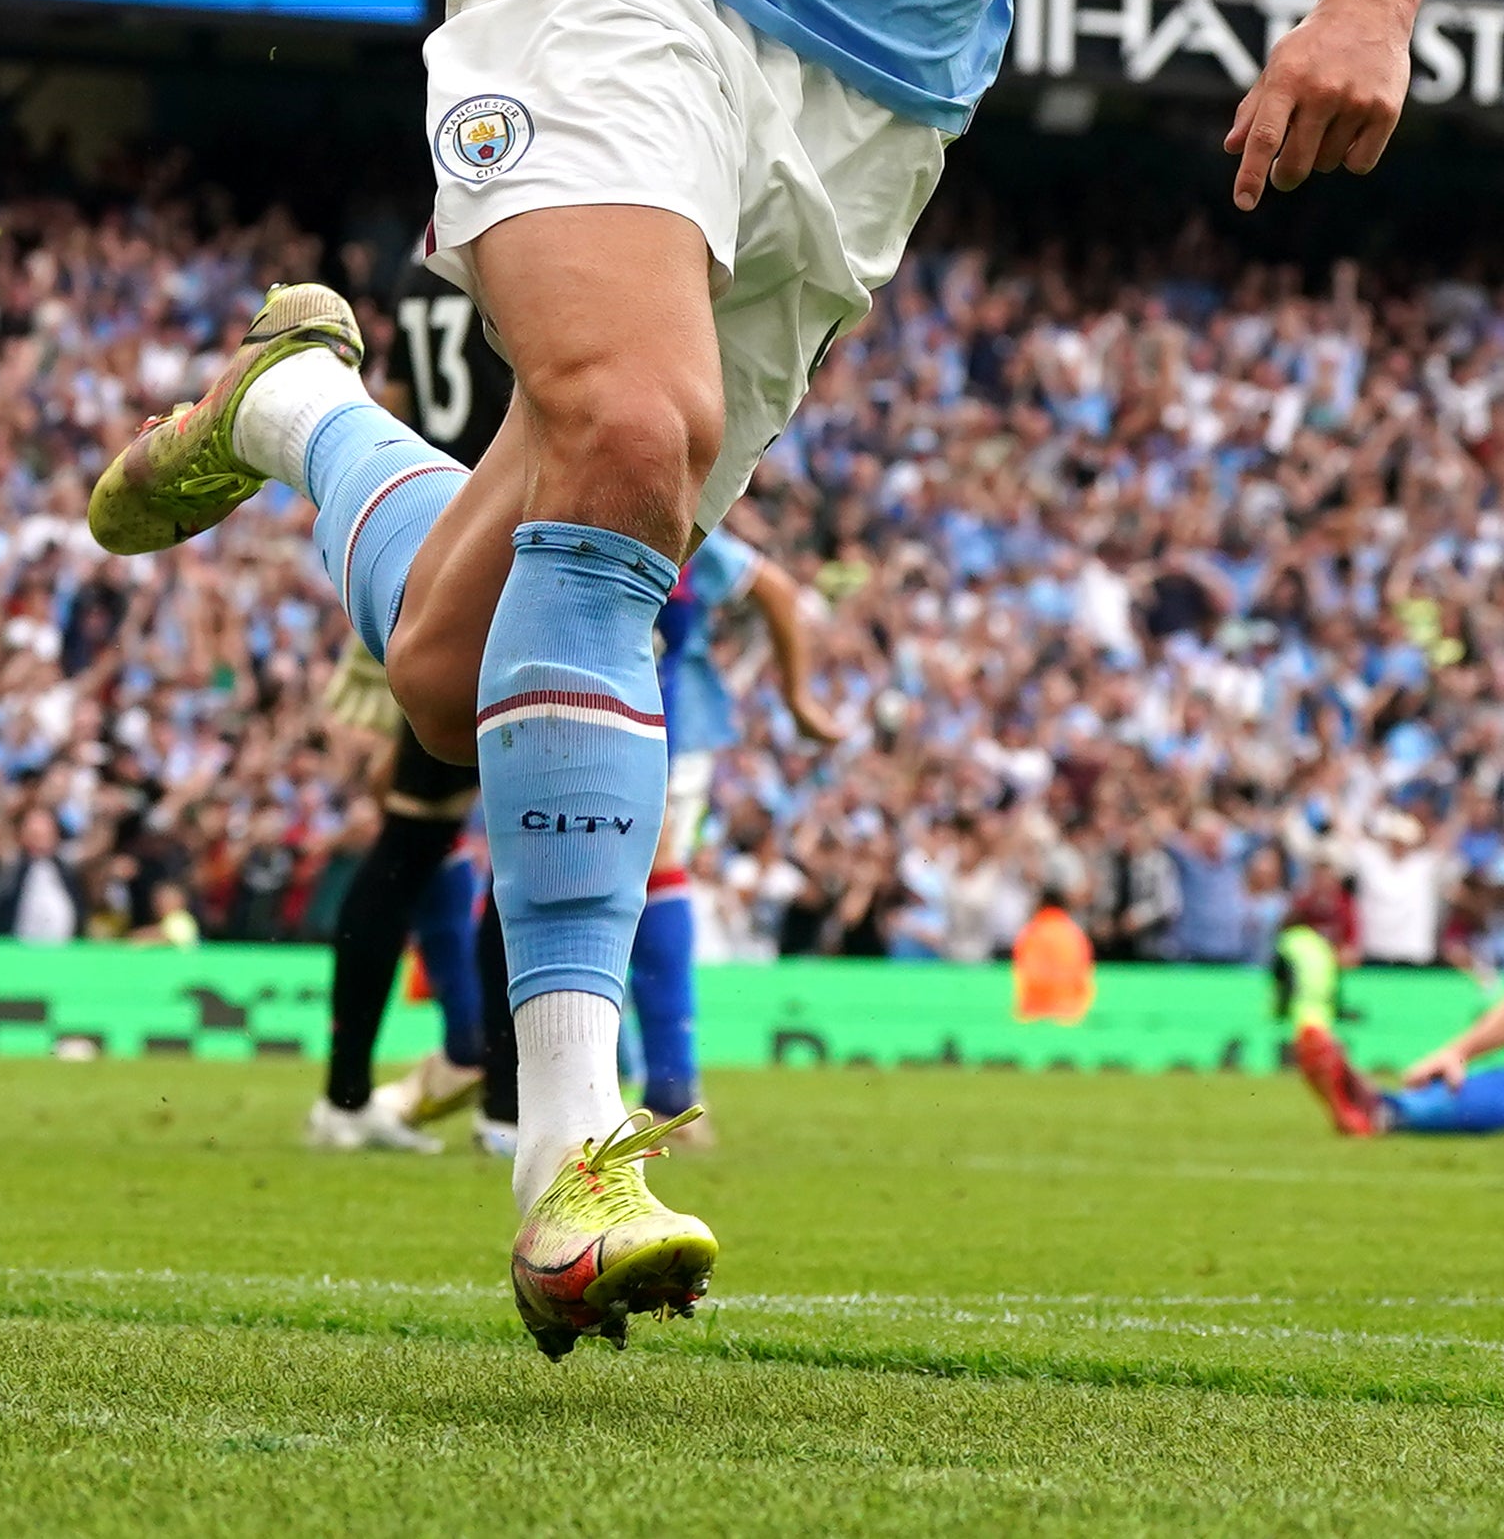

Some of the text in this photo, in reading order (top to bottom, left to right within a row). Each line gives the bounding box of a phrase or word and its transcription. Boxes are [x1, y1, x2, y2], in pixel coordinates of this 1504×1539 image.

[443, 100, 520, 136] MANCHESTER
[475, 164, 504, 179] CITY
[399, 293, 474, 444] 13
[520, 809, 634, 835] CITY
